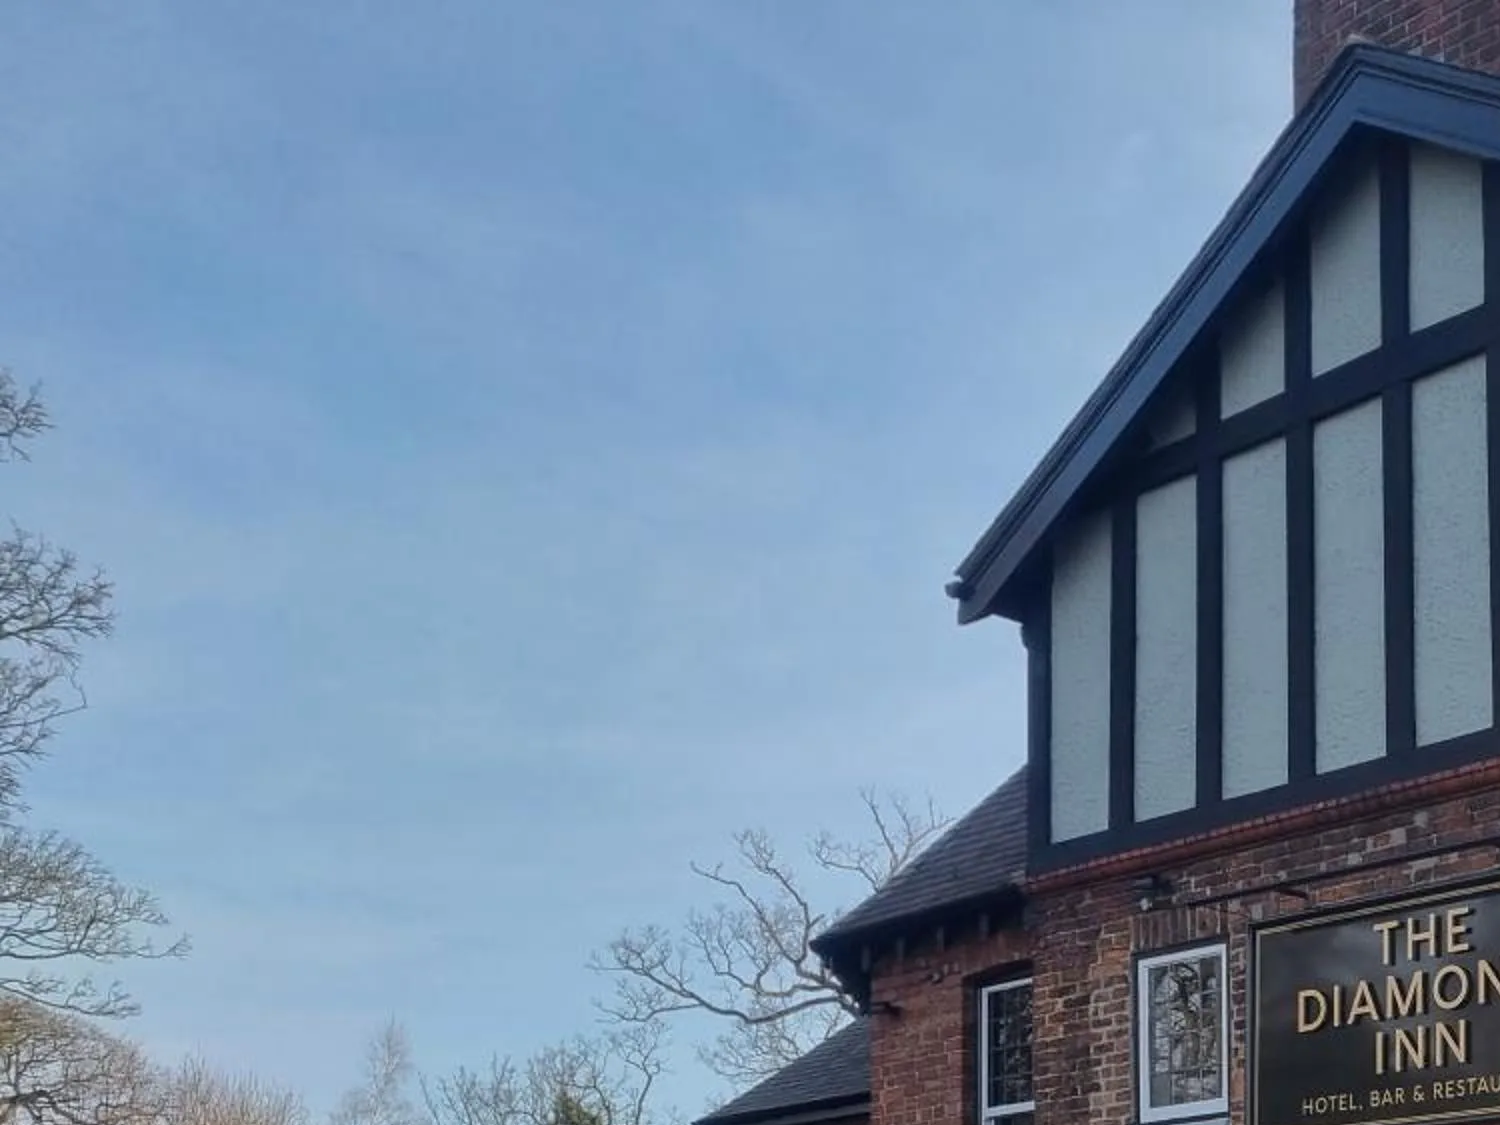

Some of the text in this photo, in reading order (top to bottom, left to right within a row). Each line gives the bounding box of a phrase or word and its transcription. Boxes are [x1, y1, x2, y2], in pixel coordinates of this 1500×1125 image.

[1373, 907, 1470, 966] THE
[1375, 1019, 1467, 1075] INN
[1369, 1087, 1406, 1107] BAR
[1413, 1084, 1425, 1102] &
